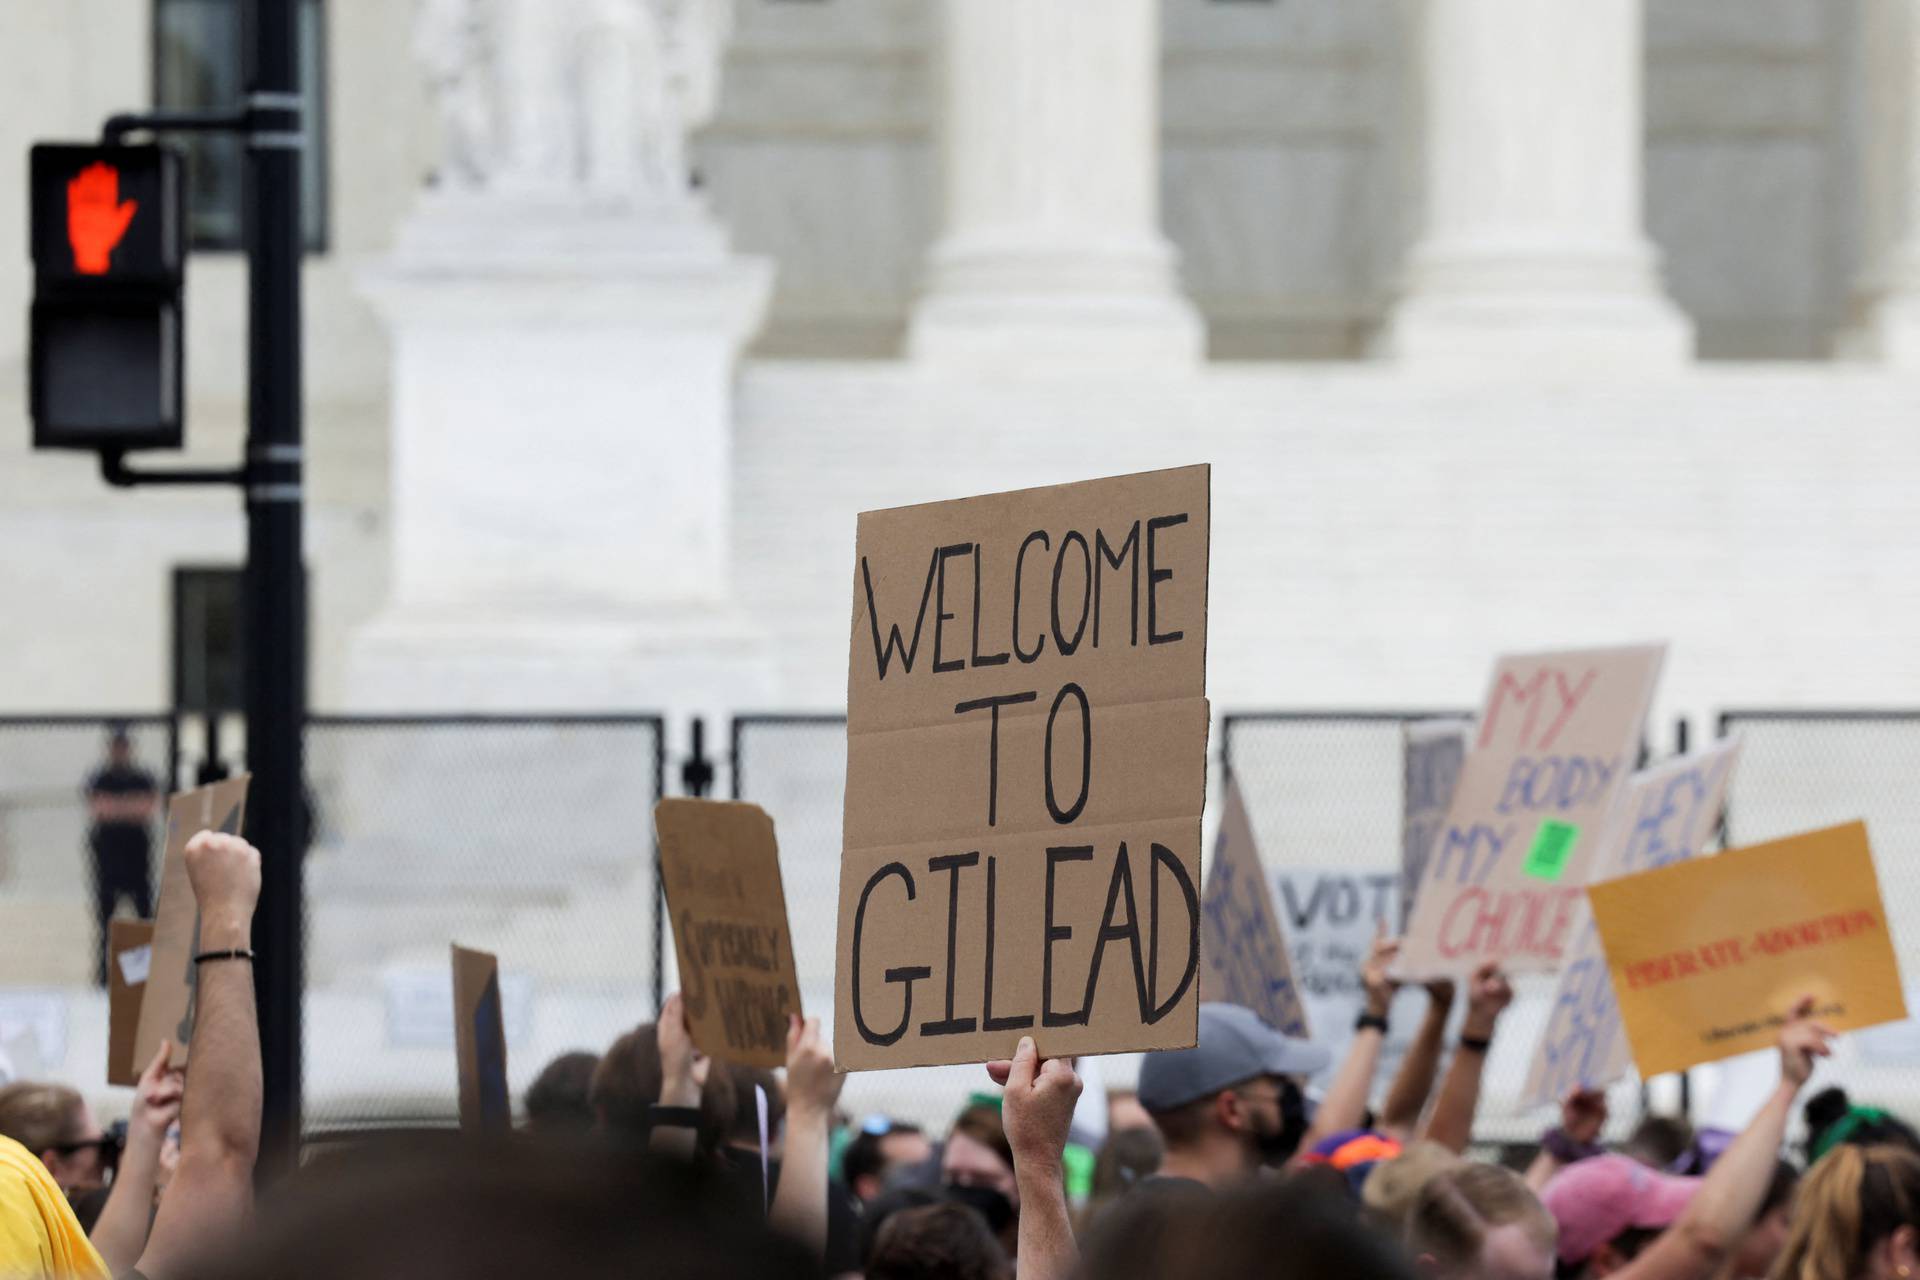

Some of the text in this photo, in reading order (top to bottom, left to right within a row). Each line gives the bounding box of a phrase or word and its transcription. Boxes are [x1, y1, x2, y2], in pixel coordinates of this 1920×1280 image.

[862, 512, 1188, 680] WELCOME
[1476, 666, 1598, 750] MY
[955, 682, 1091, 826] TO
[1494, 754, 1625, 815] BODY
[1435, 822, 1519, 884] MY
[852, 841, 1200, 1046] GILEAD
[1280, 874, 1398, 930] VOT
